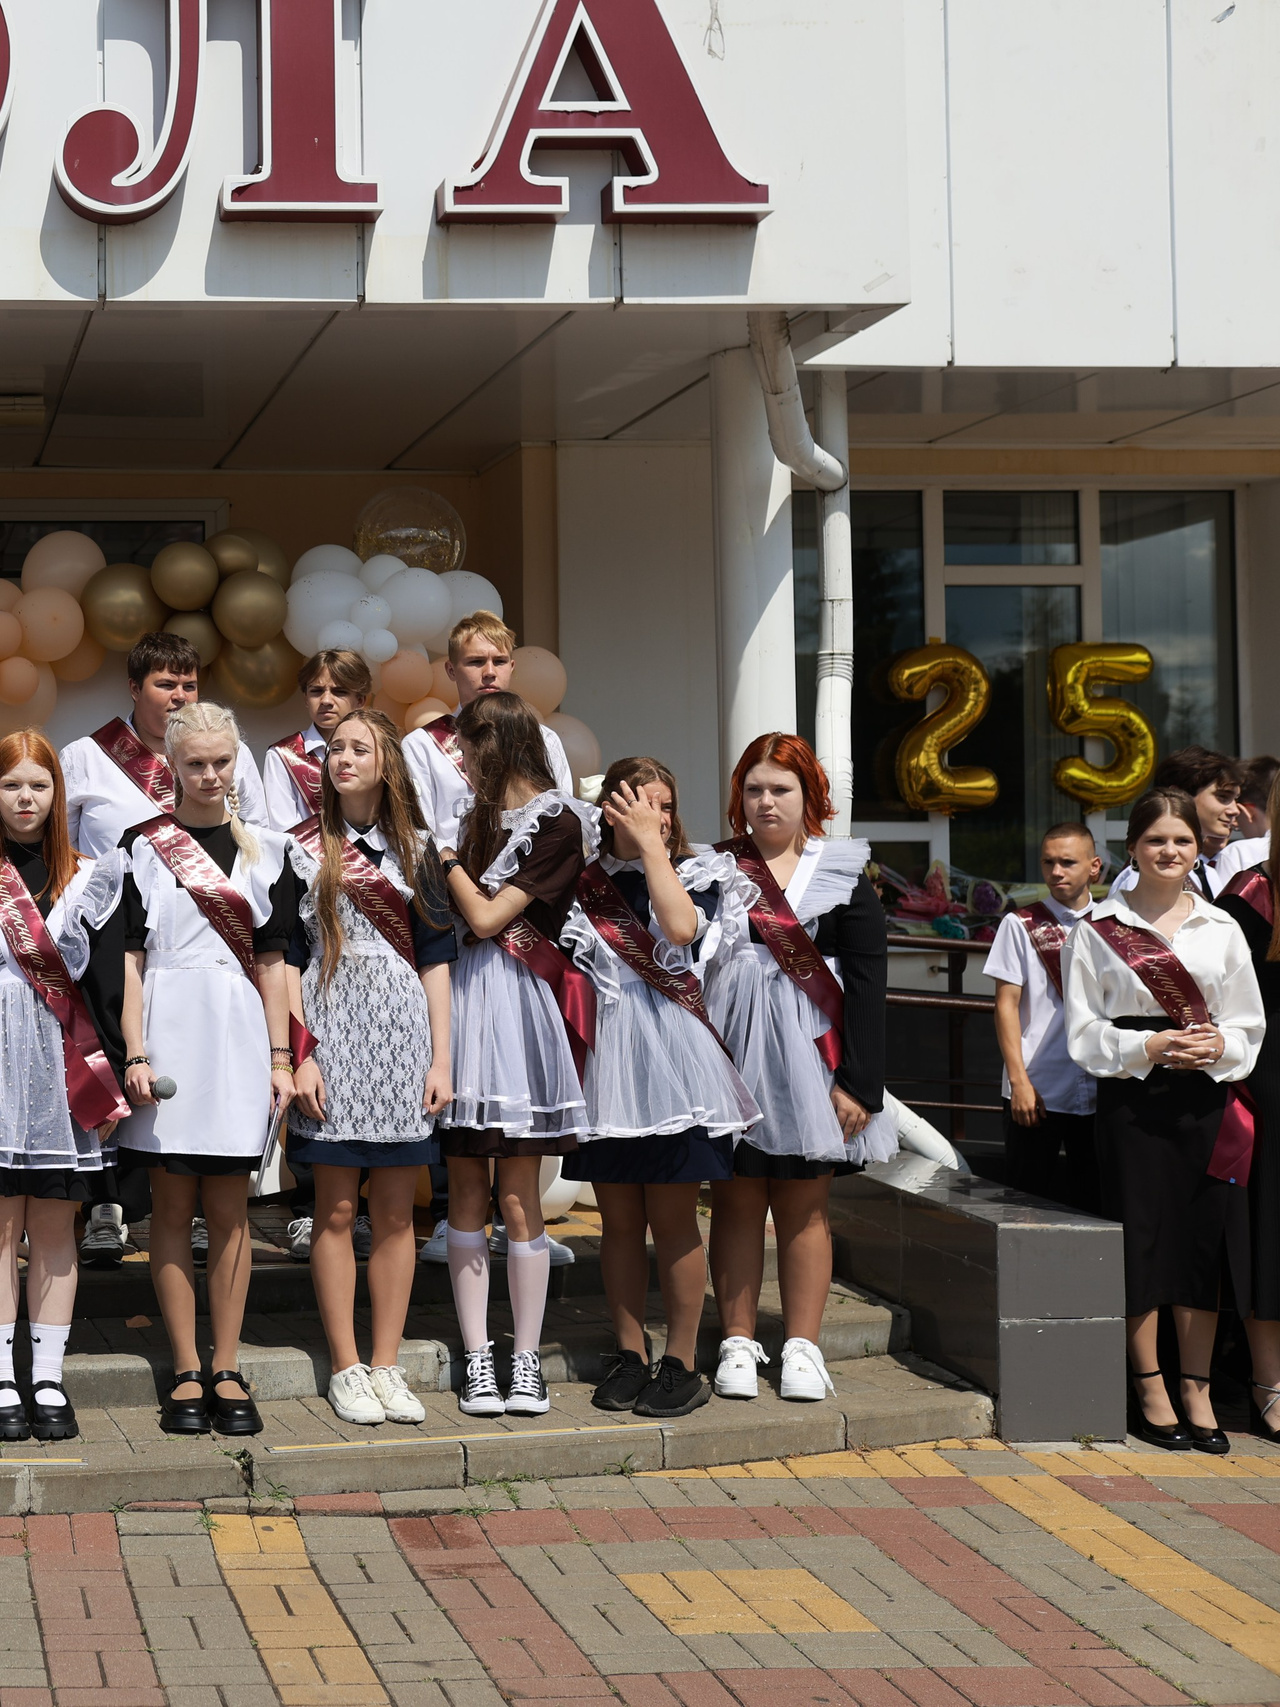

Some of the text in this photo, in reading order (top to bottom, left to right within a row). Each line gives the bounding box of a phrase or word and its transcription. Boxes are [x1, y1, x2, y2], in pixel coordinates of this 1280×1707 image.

[503, 922, 539, 952] 2025
[786, 952, 820, 979] 2025
[34, 969, 71, 1000] 2025
